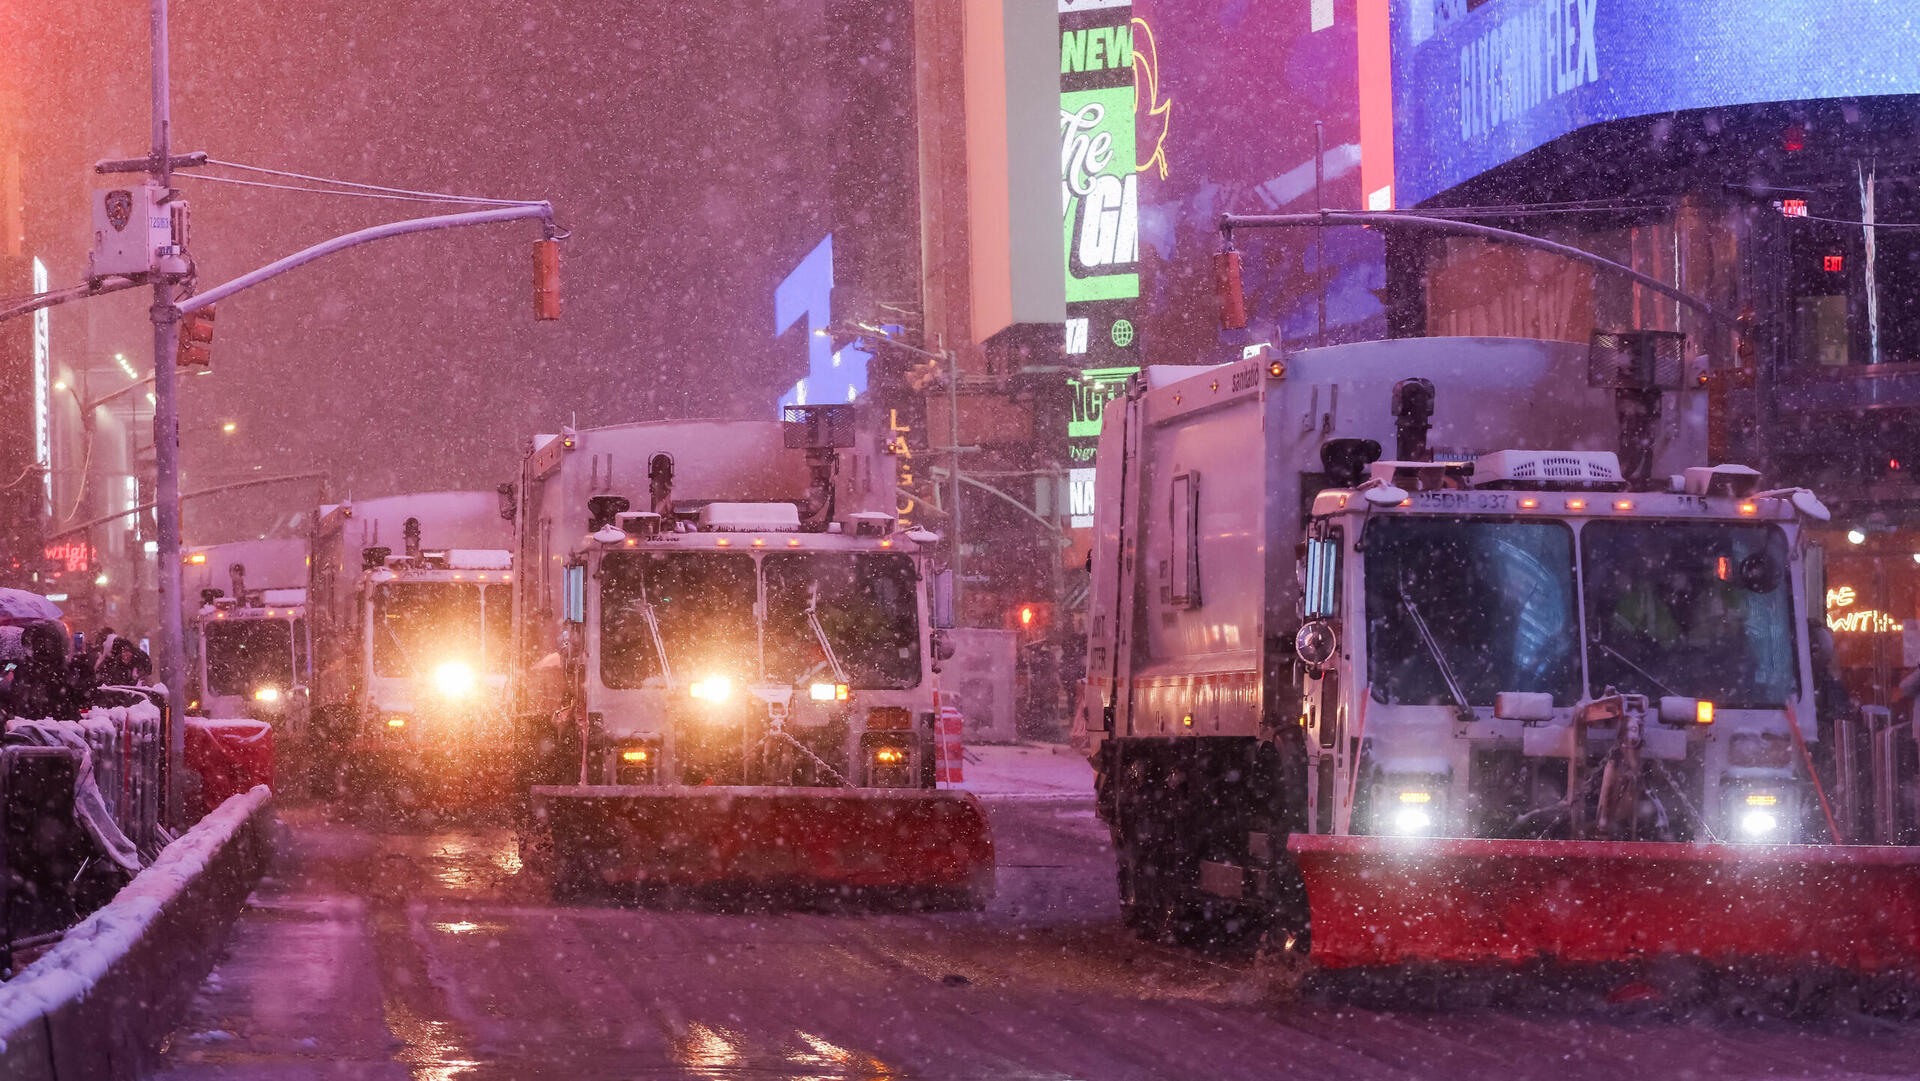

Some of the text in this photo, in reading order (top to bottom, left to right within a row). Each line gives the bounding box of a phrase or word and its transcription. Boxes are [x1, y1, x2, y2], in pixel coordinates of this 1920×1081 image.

[1060, 25, 1134, 73] NEW
[1546, 0, 1599, 100] FLEX
[1823, 255, 1844, 272] EXIT
